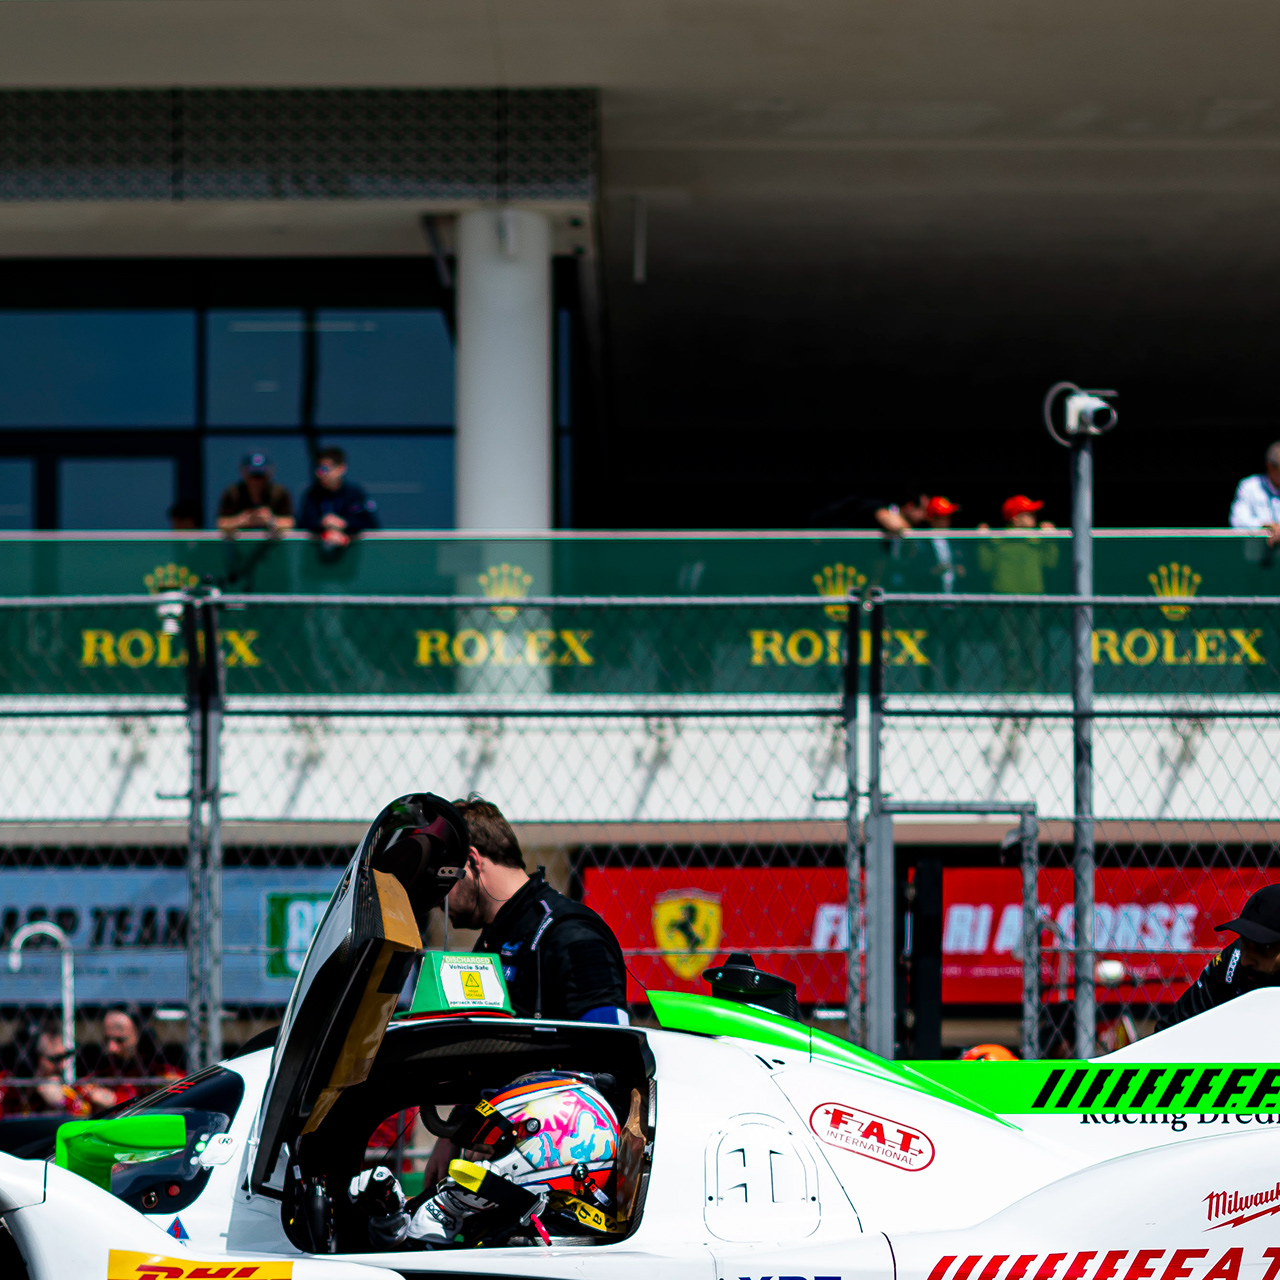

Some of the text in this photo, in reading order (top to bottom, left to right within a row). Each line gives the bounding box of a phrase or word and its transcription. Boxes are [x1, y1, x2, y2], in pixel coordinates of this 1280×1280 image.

[414, 629, 594, 667] ROLEX
[1090, 628, 1266, 665] ROLEX
[826, 1130, 914, 1166] INTERNATIONAL
